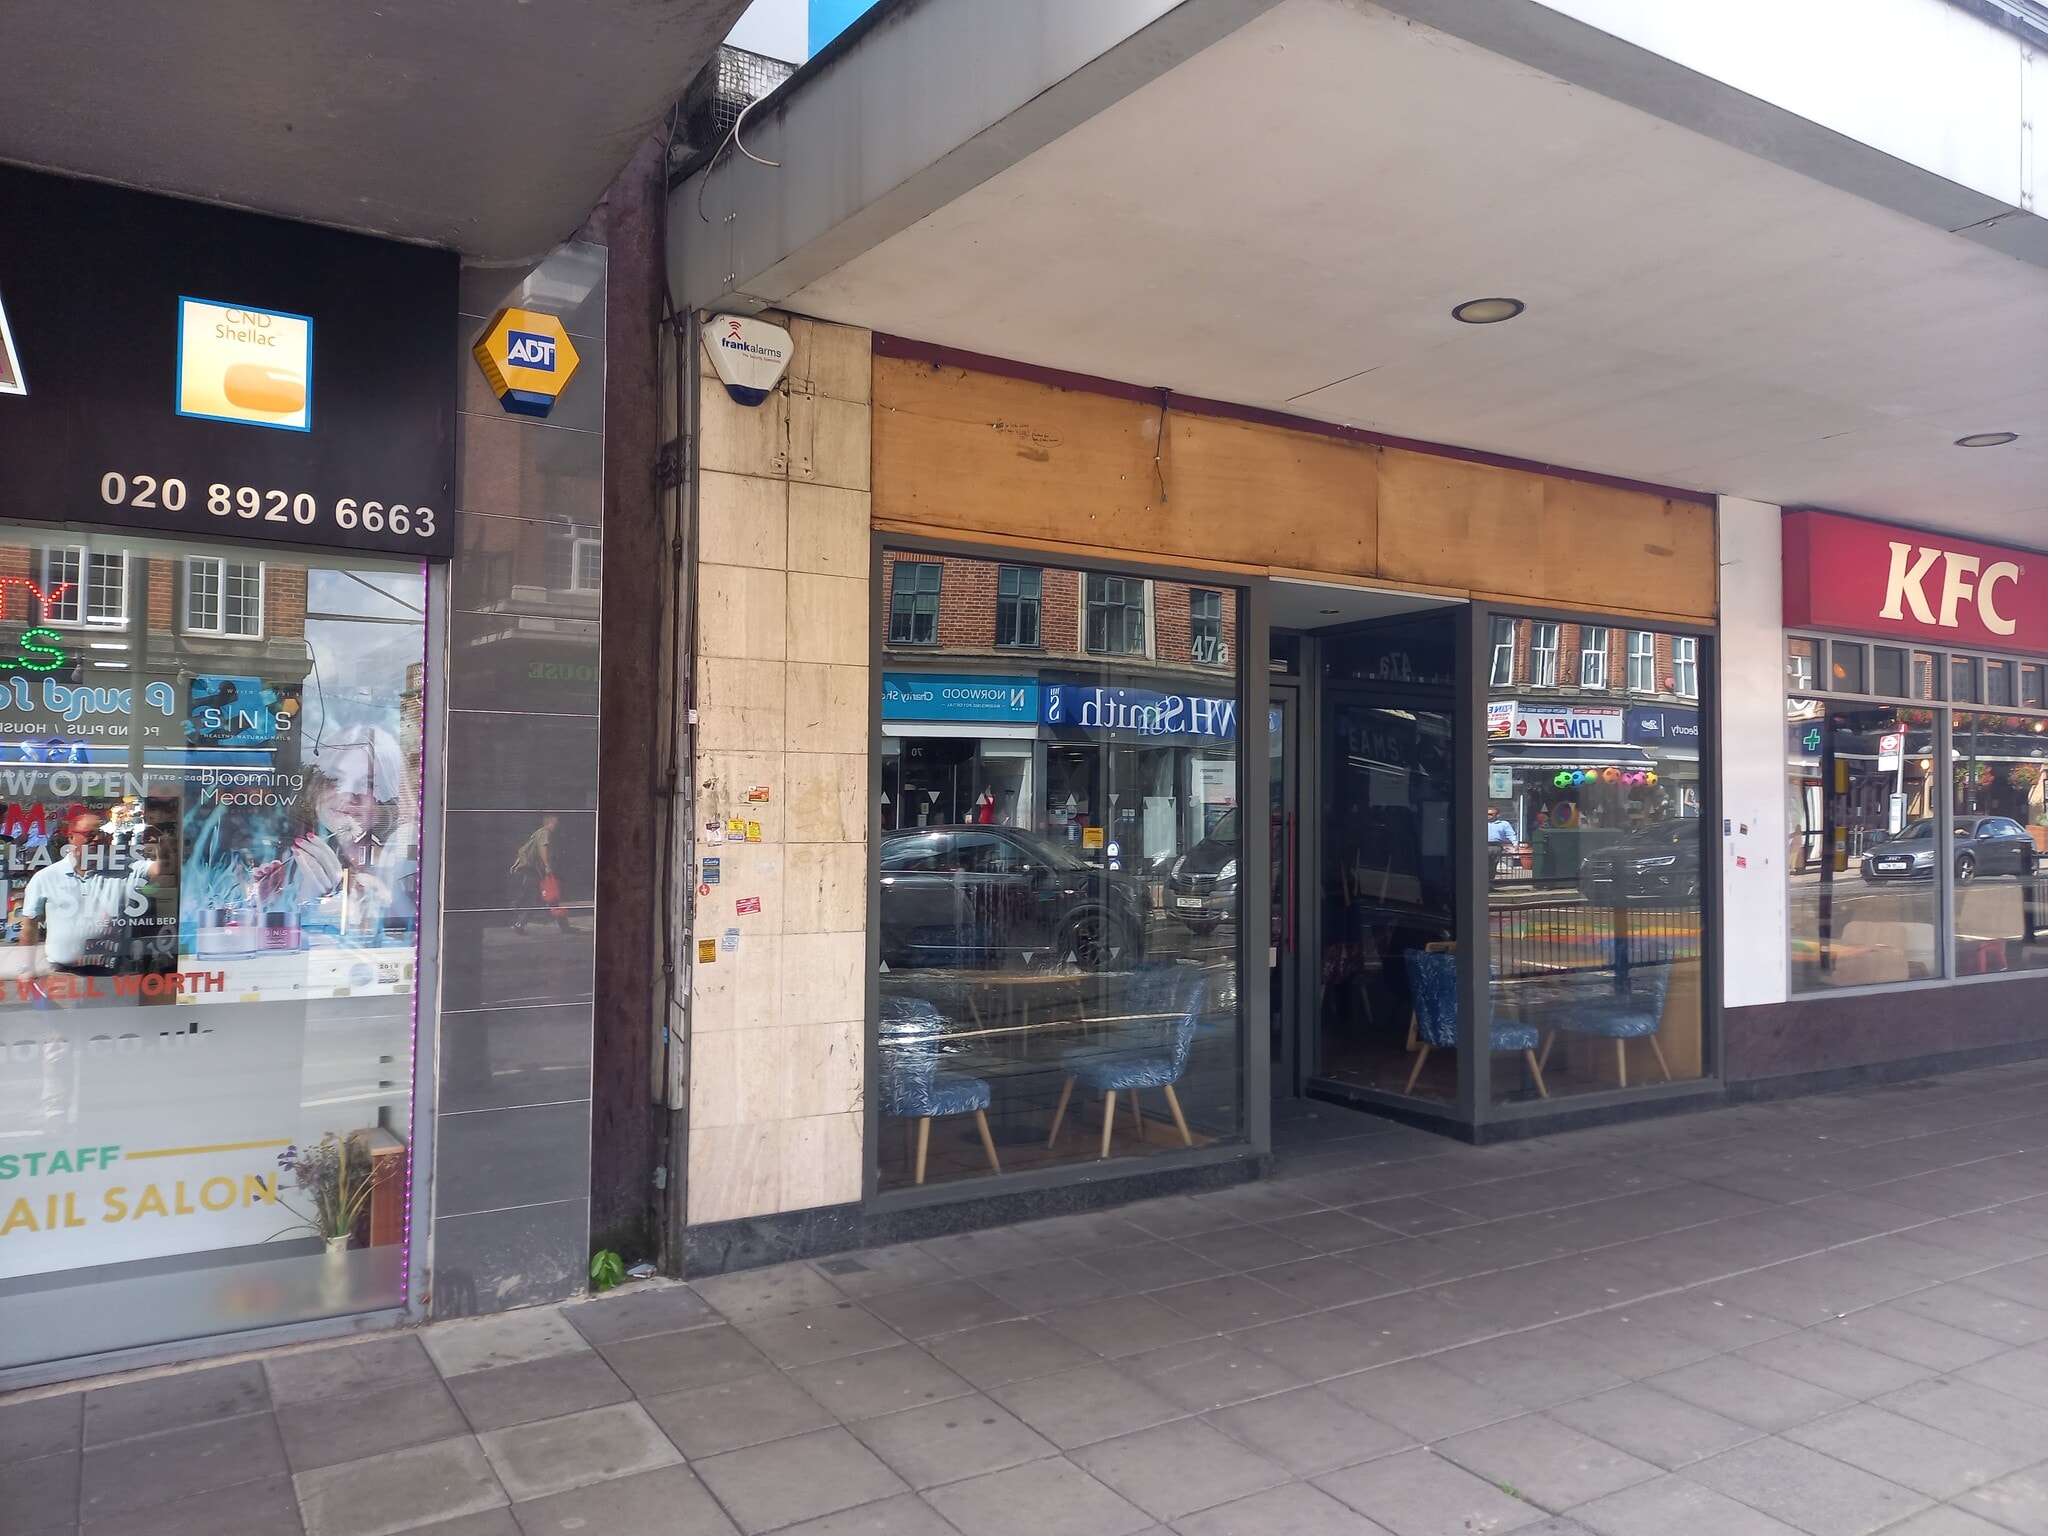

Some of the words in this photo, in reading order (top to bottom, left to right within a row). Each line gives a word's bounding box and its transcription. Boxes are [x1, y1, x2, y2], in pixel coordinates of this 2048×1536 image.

[226, 308, 272, 328] CND
[215, 324, 276, 347] Shellac
[722, 338, 782, 358] frankalarms
[508, 338, 555, 365] ADT
[101, 471, 187, 511] 020
[206, 483, 316, 526] 8920
[335, 498, 436, 538] 6663
[1879, 541, 2019, 635] KFC
[1191, 636, 1229, 667] 47a
[50, 770, 149, 798] OPEN
[201, 768, 304, 790] Blooming
[200, 788, 297, 806] Meadow
[111, 918, 126, 927] TO
[128, 917, 153, 926] NAIL
[156, 916, 177, 925] BED
[16, 976, 104, 1000] WELL
[111, 971, 225, 997] WORTH
[0, 1145, 121, 1180] STAFF
[102, 1171, 277, 1223] SALON
